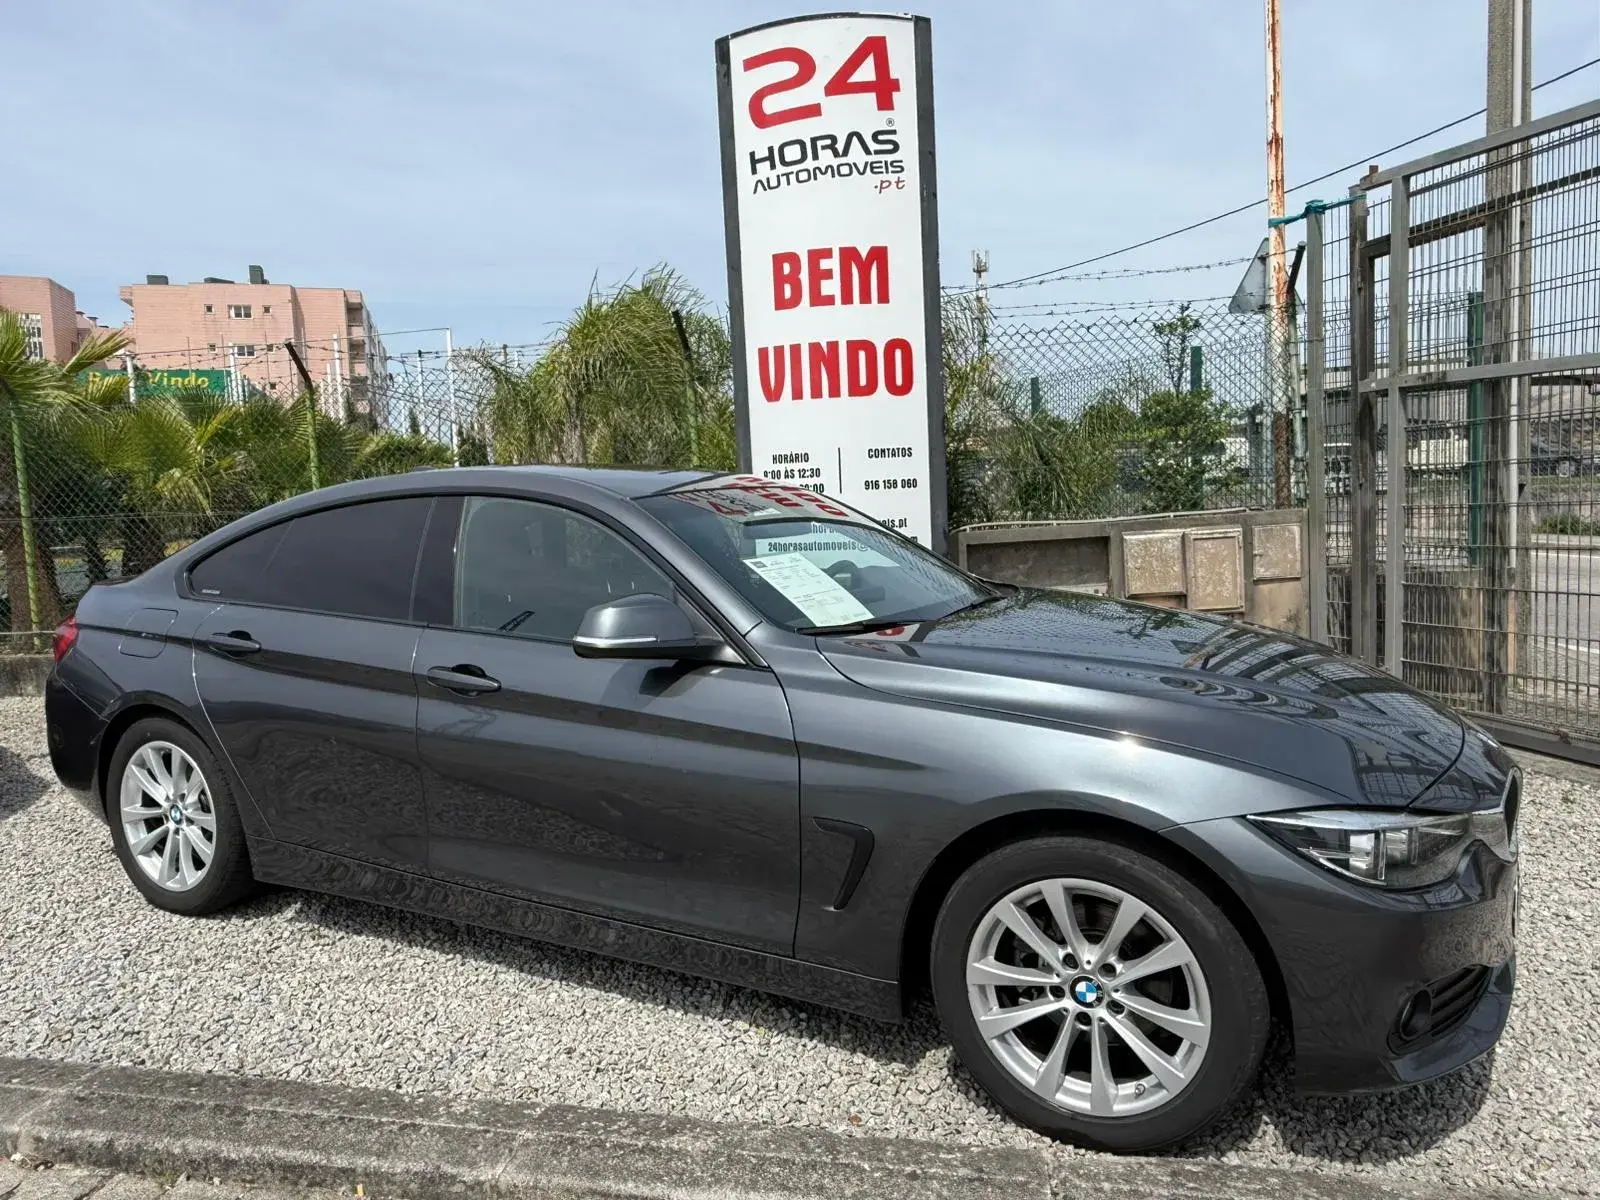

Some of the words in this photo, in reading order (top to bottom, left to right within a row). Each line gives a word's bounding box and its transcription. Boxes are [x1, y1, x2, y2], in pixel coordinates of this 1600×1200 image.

[742, 36, 901, 130] 24
[749, 129, 900, 175] HORAS
[753, 160, 905, 194] AUTOMOVEIS
[874, 176, 905, 193] .pt
[772, 246, 890, 311] BEM
[758, 338, 914, 402] VINDO
[772, 451, 810, 464] HORÁRIO
[867, 447, 913, 459] CONTATOS
[797, 467, 821, 479] 12:30
[864, 480, 880, 490] 916
[882, 479, 898, 490] 158
[900, 478, 918, 489] 060
